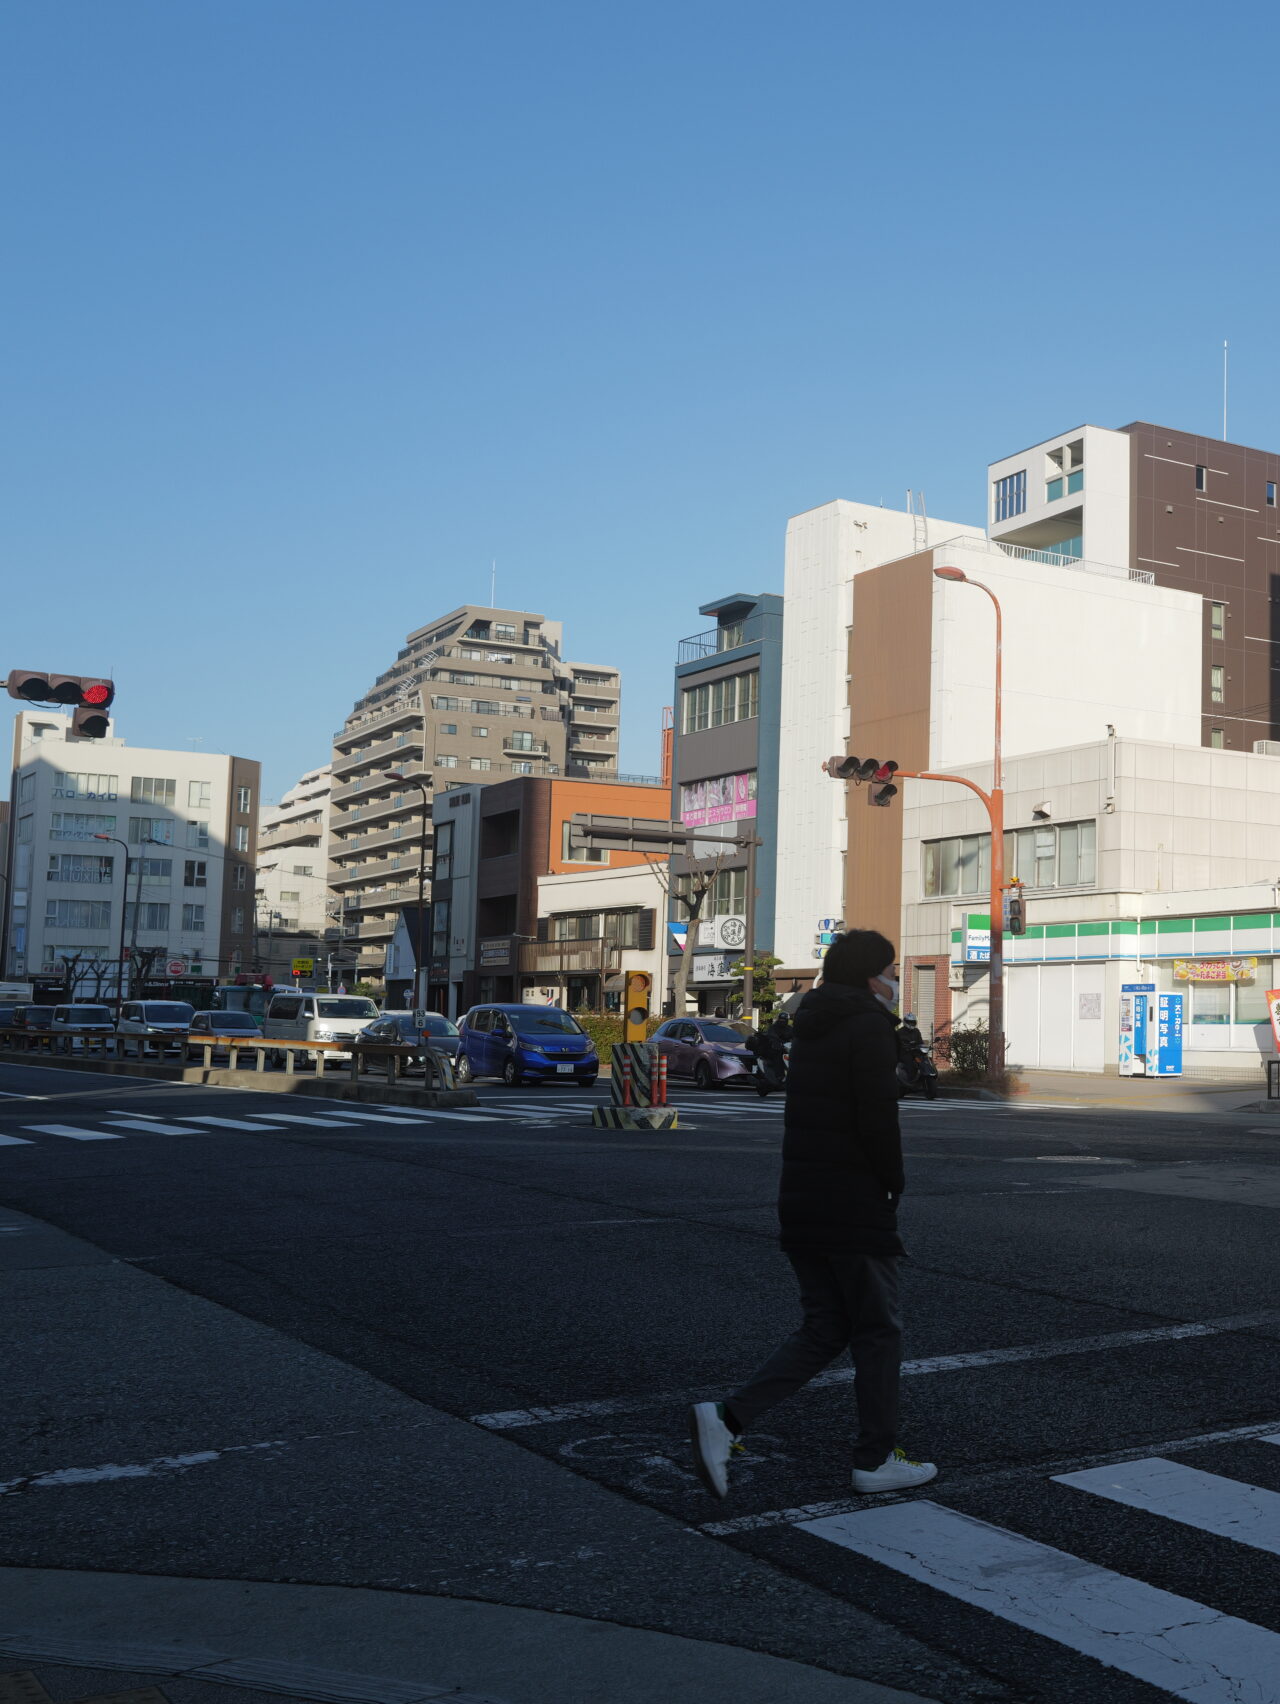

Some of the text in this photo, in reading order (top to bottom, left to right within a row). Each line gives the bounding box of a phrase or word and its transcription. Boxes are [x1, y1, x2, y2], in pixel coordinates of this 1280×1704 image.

[969, 950, 991, 960] 酒 たば
[418, 1019, 424, 1027] 6
[1159, 996, 1169, 1048] 証明写真
